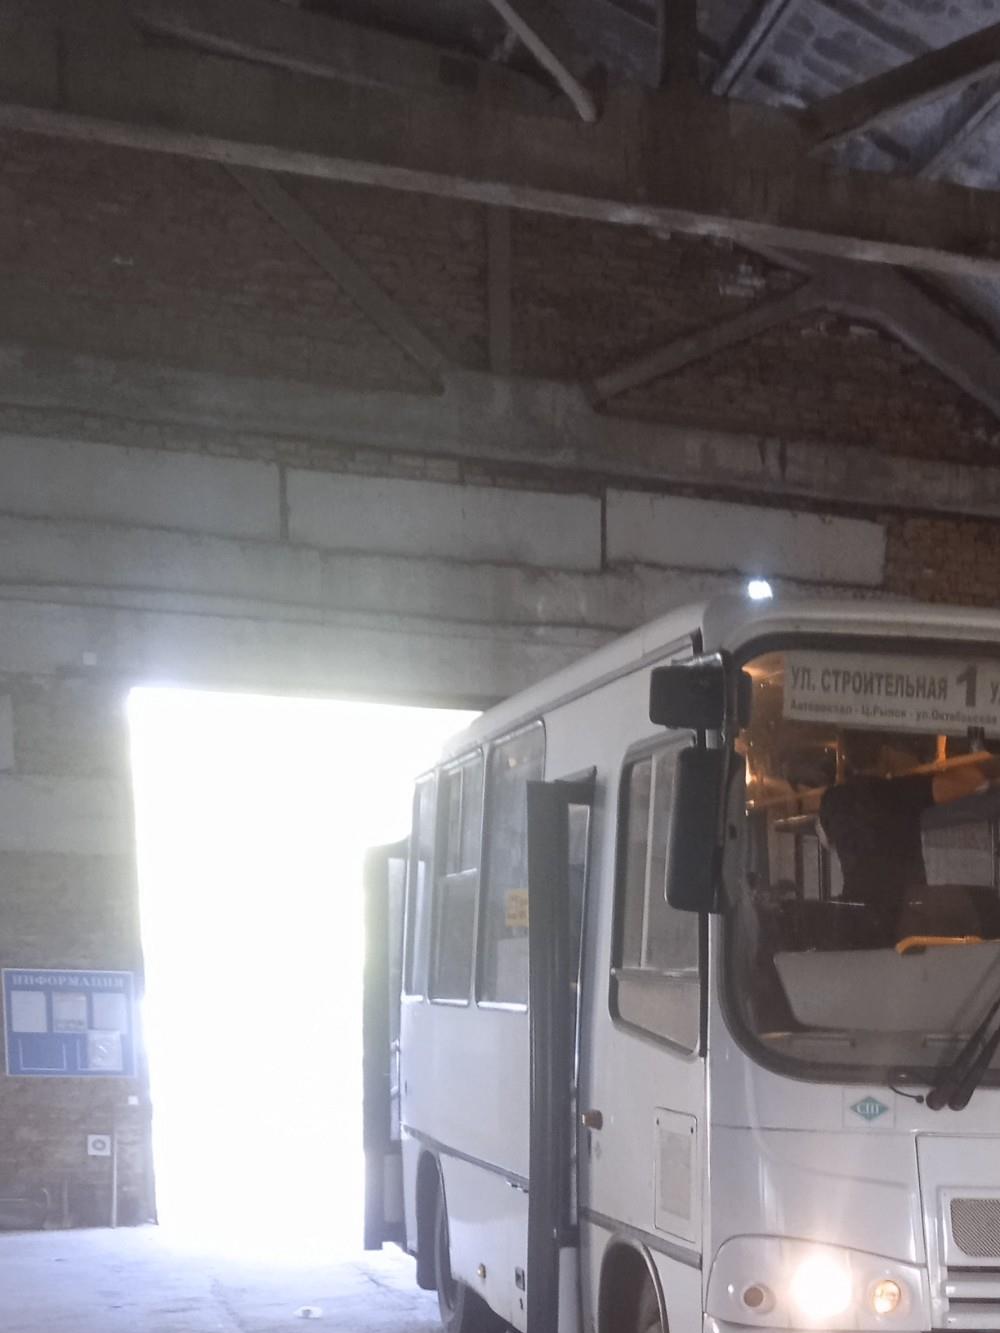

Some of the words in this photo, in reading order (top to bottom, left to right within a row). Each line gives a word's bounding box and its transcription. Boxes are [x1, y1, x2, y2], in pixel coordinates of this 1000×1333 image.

[790, 666, 816, 691] УЛ.
[821, 667, 947, 700] СТРОИТЕЛЬНАЯ
[956, 664, 977, 708] 1
[12, 975, 124, 987] ИНФОРМАЦИЯ
